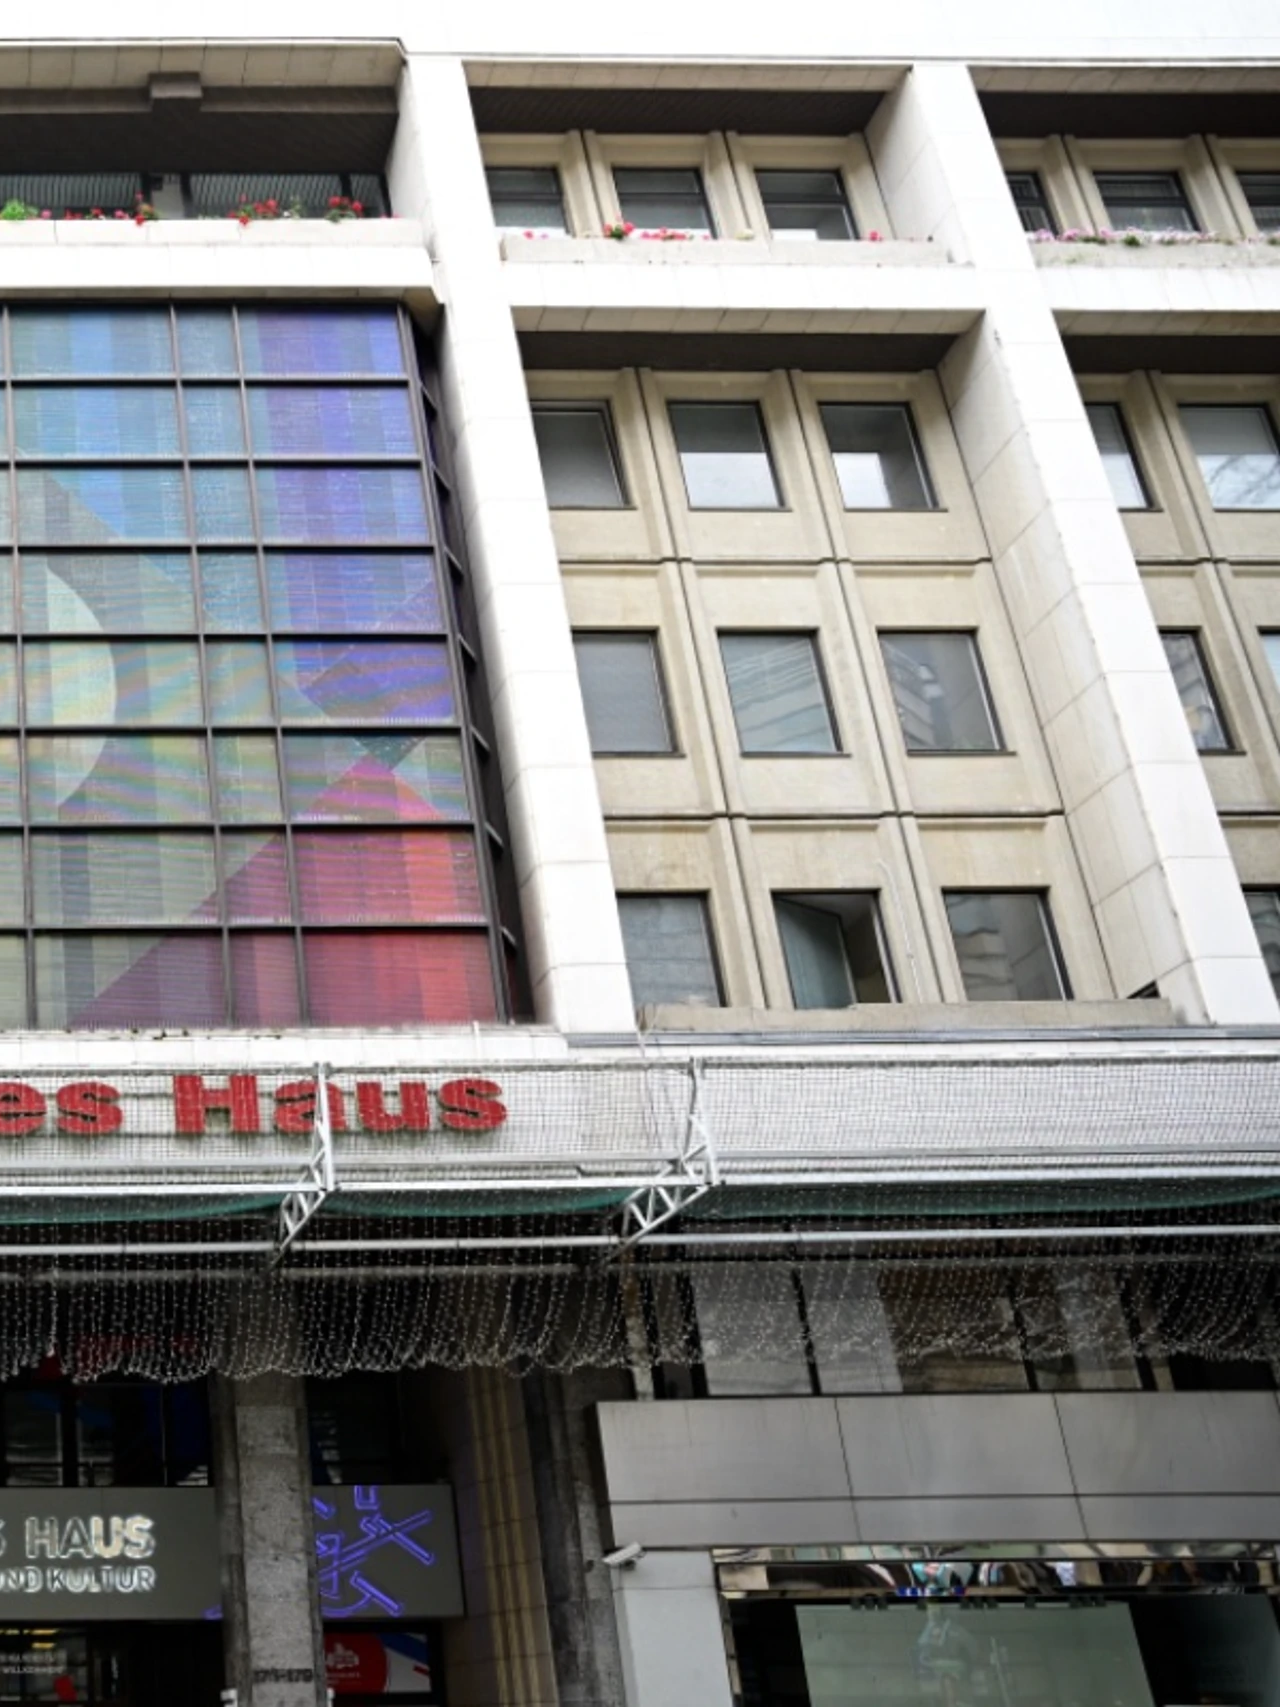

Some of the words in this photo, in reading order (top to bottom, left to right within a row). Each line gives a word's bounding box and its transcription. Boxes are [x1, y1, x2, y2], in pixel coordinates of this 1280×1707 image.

[173, 1073, 507, 1134] Haus
[24, 1515, 157, 1559] HAUS
[47, 1564, 157, 1592] KULTUR
